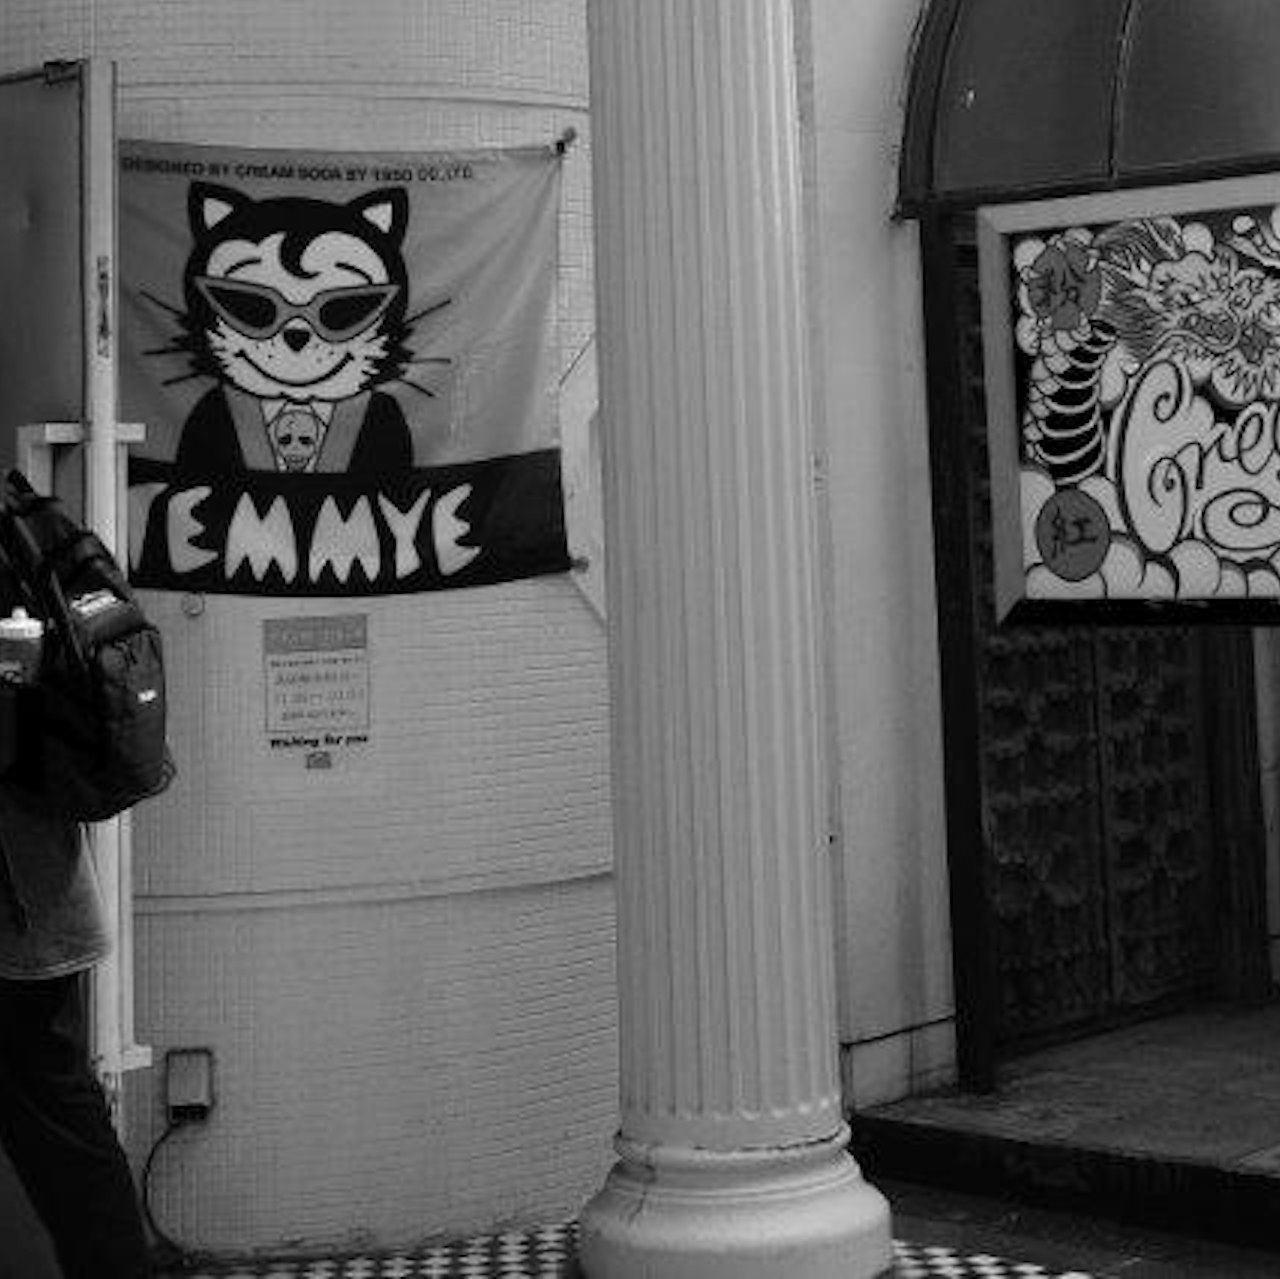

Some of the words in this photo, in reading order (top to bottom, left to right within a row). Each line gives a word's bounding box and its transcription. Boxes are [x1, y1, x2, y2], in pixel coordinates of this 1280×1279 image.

[234, 163, 294, 179] CREAM
[297, 164, 342, 181] SODA
[345, 167, 367, 181] BY
[1050, 505, 1099, 559] 紅
